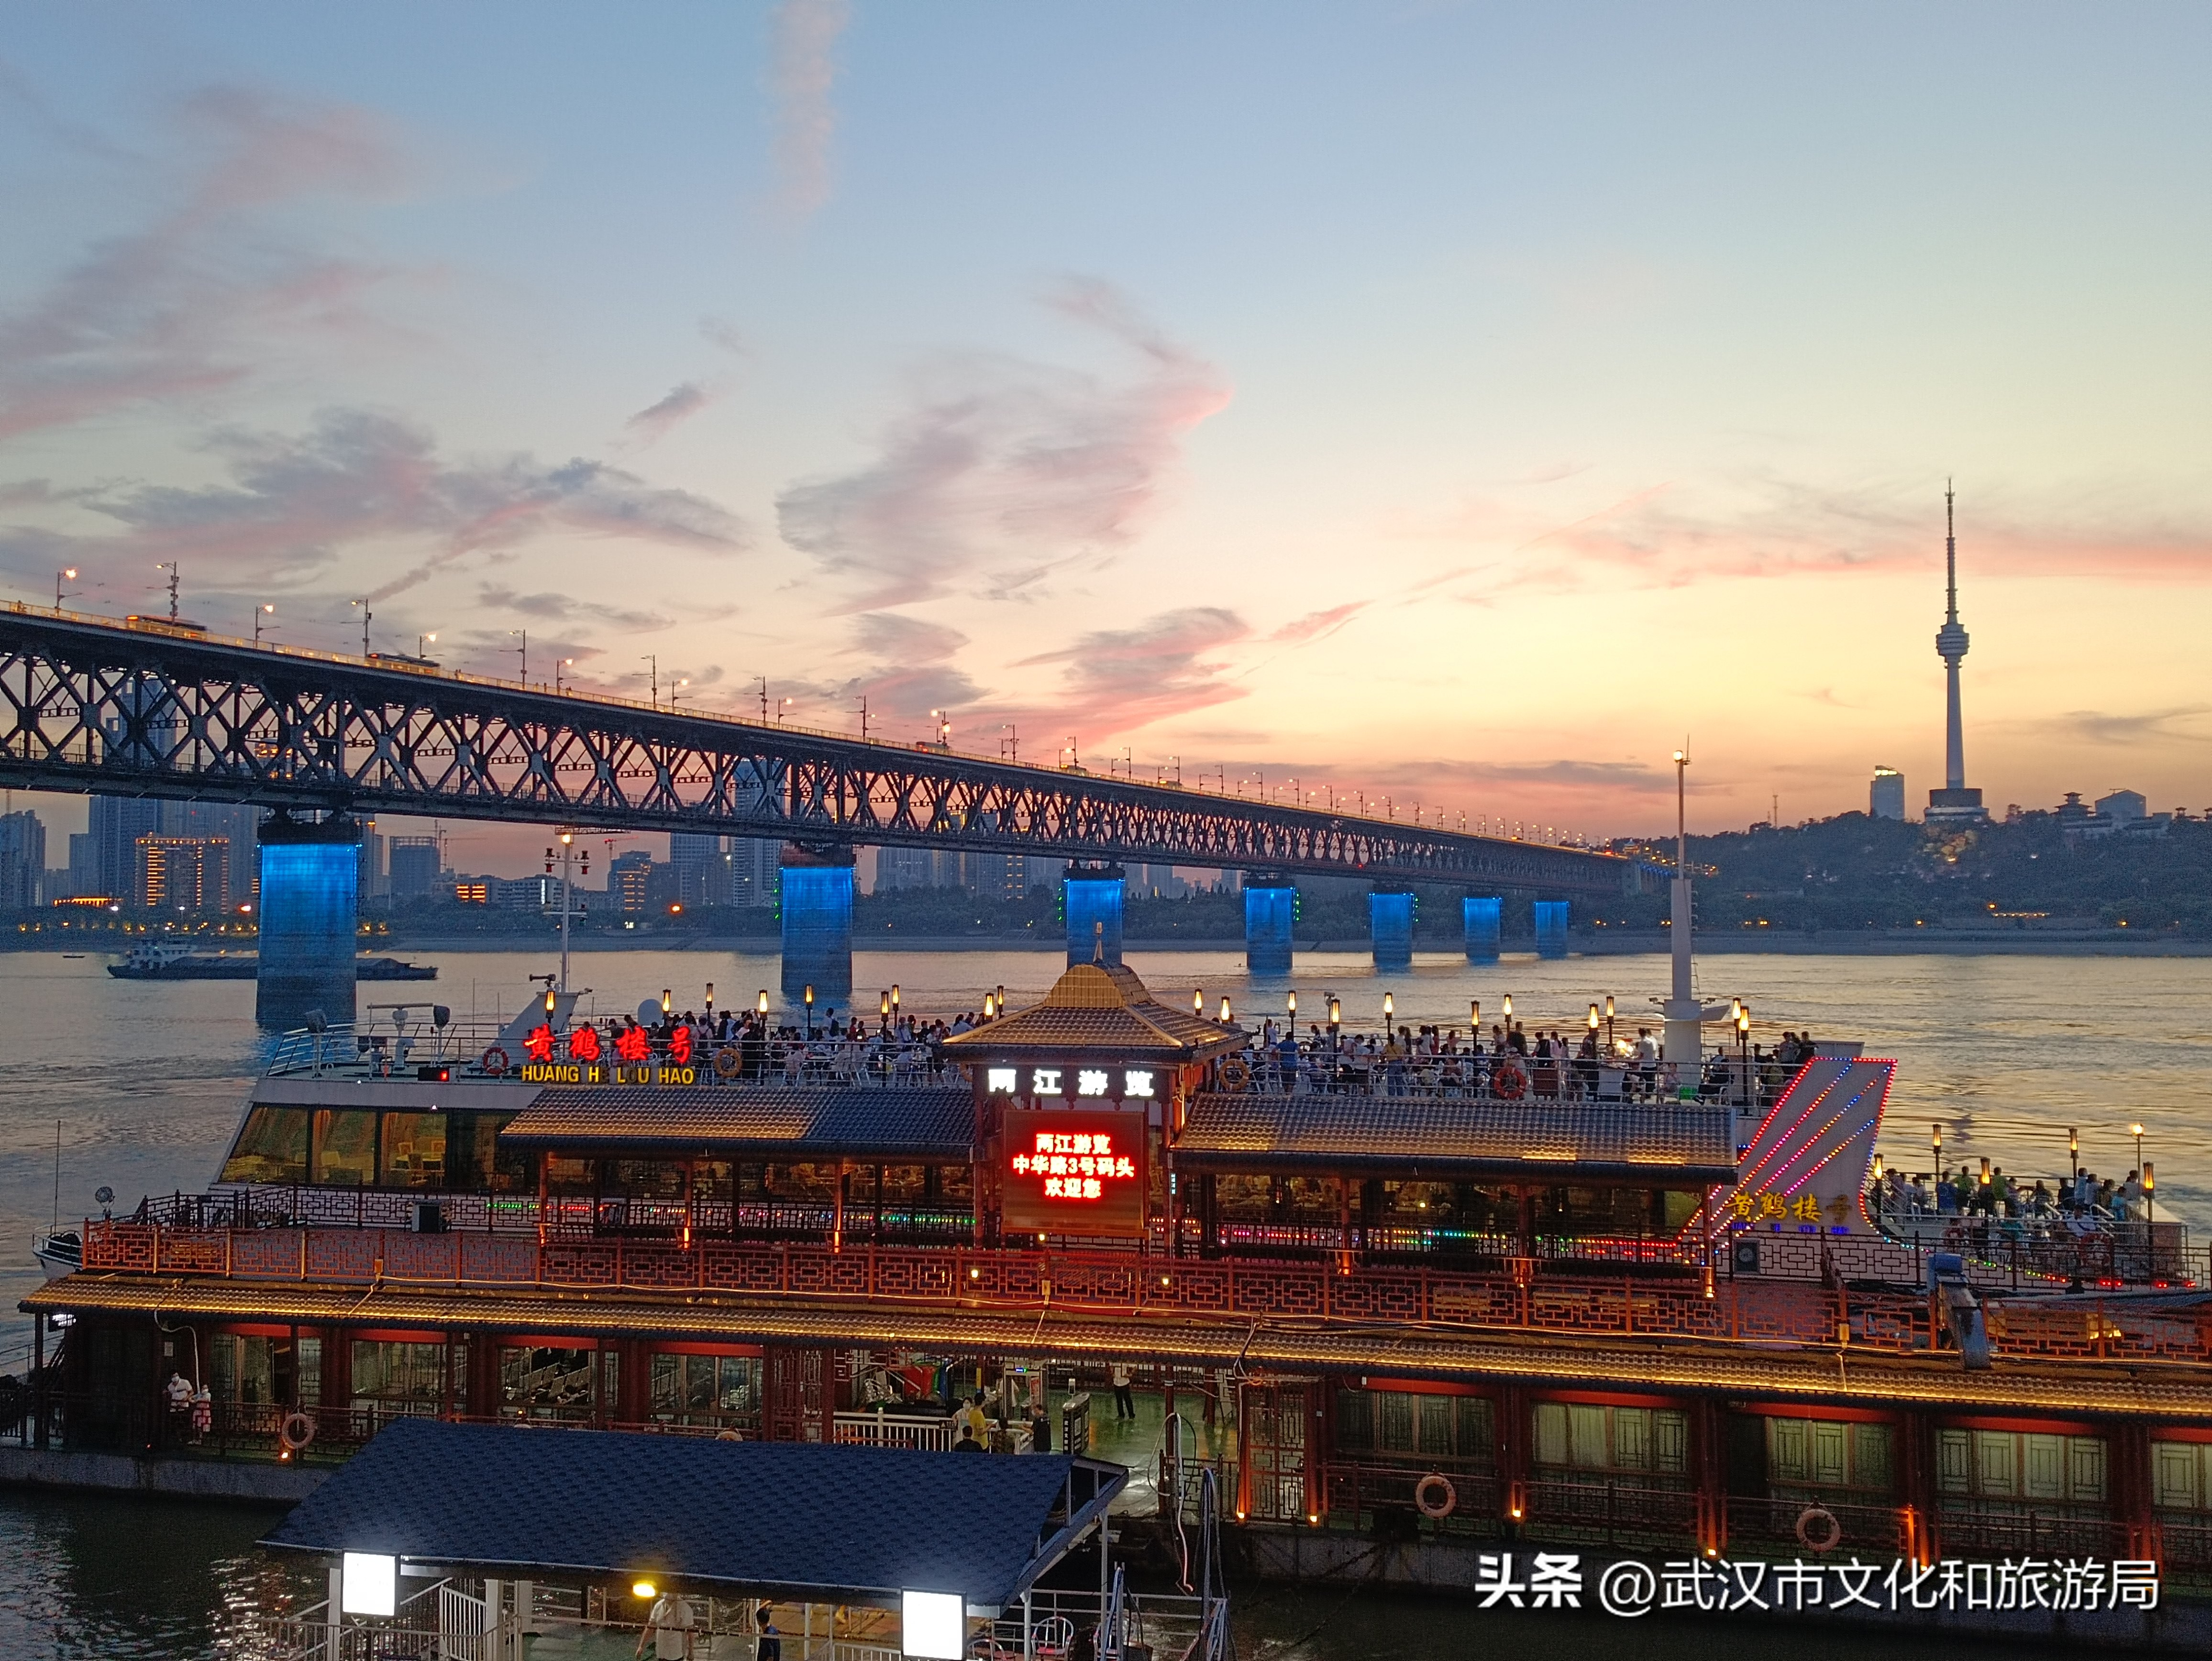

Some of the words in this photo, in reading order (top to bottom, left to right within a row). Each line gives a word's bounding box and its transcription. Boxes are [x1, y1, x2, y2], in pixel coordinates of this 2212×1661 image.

[523, 1023, 691, 1064] 黄鹤楼号
[522, 1065, 579, 1083] HUANG
[658, 1068, 694, 1084] HAO
[988, 1069, 1154, 1096] 两江游览
[1036, 1133, 1111, 1154] 两江游览
[1013, 1154, 1135, 1178] 中华路3号码头
[1045, 1178, 1102, 1198] 欢迎您
